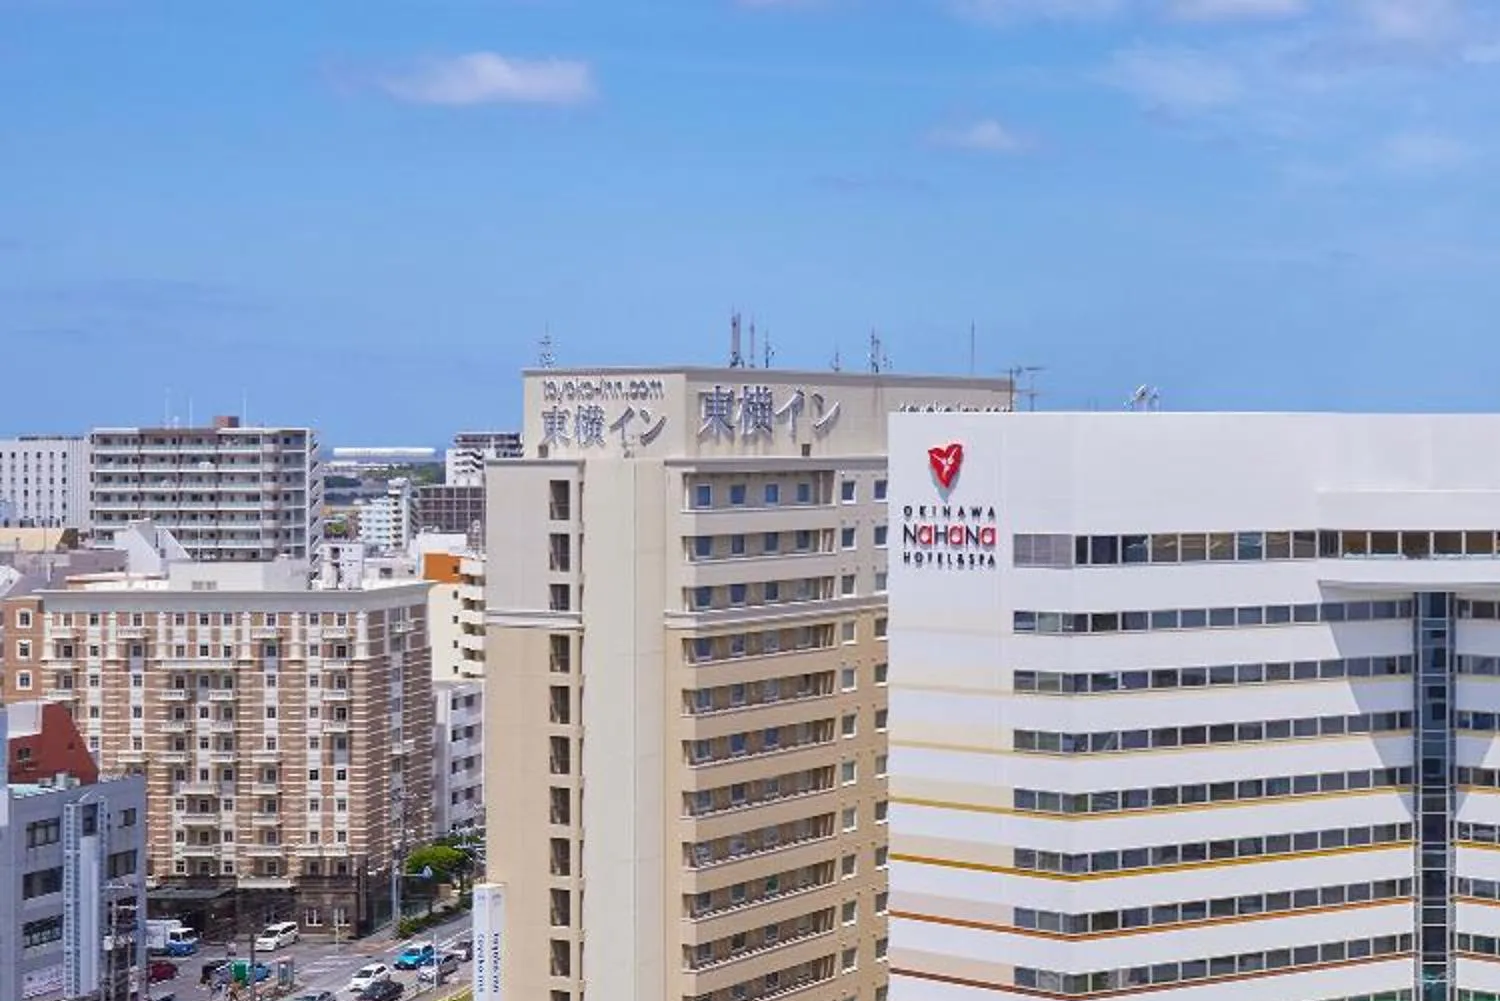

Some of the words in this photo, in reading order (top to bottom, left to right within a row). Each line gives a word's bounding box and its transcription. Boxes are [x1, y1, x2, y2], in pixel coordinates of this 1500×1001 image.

[542, 404, 666, 447] 東横イン
[698, 385, 841, 440] 東横イン
[903, 505, 995, 518] OKINAWA
